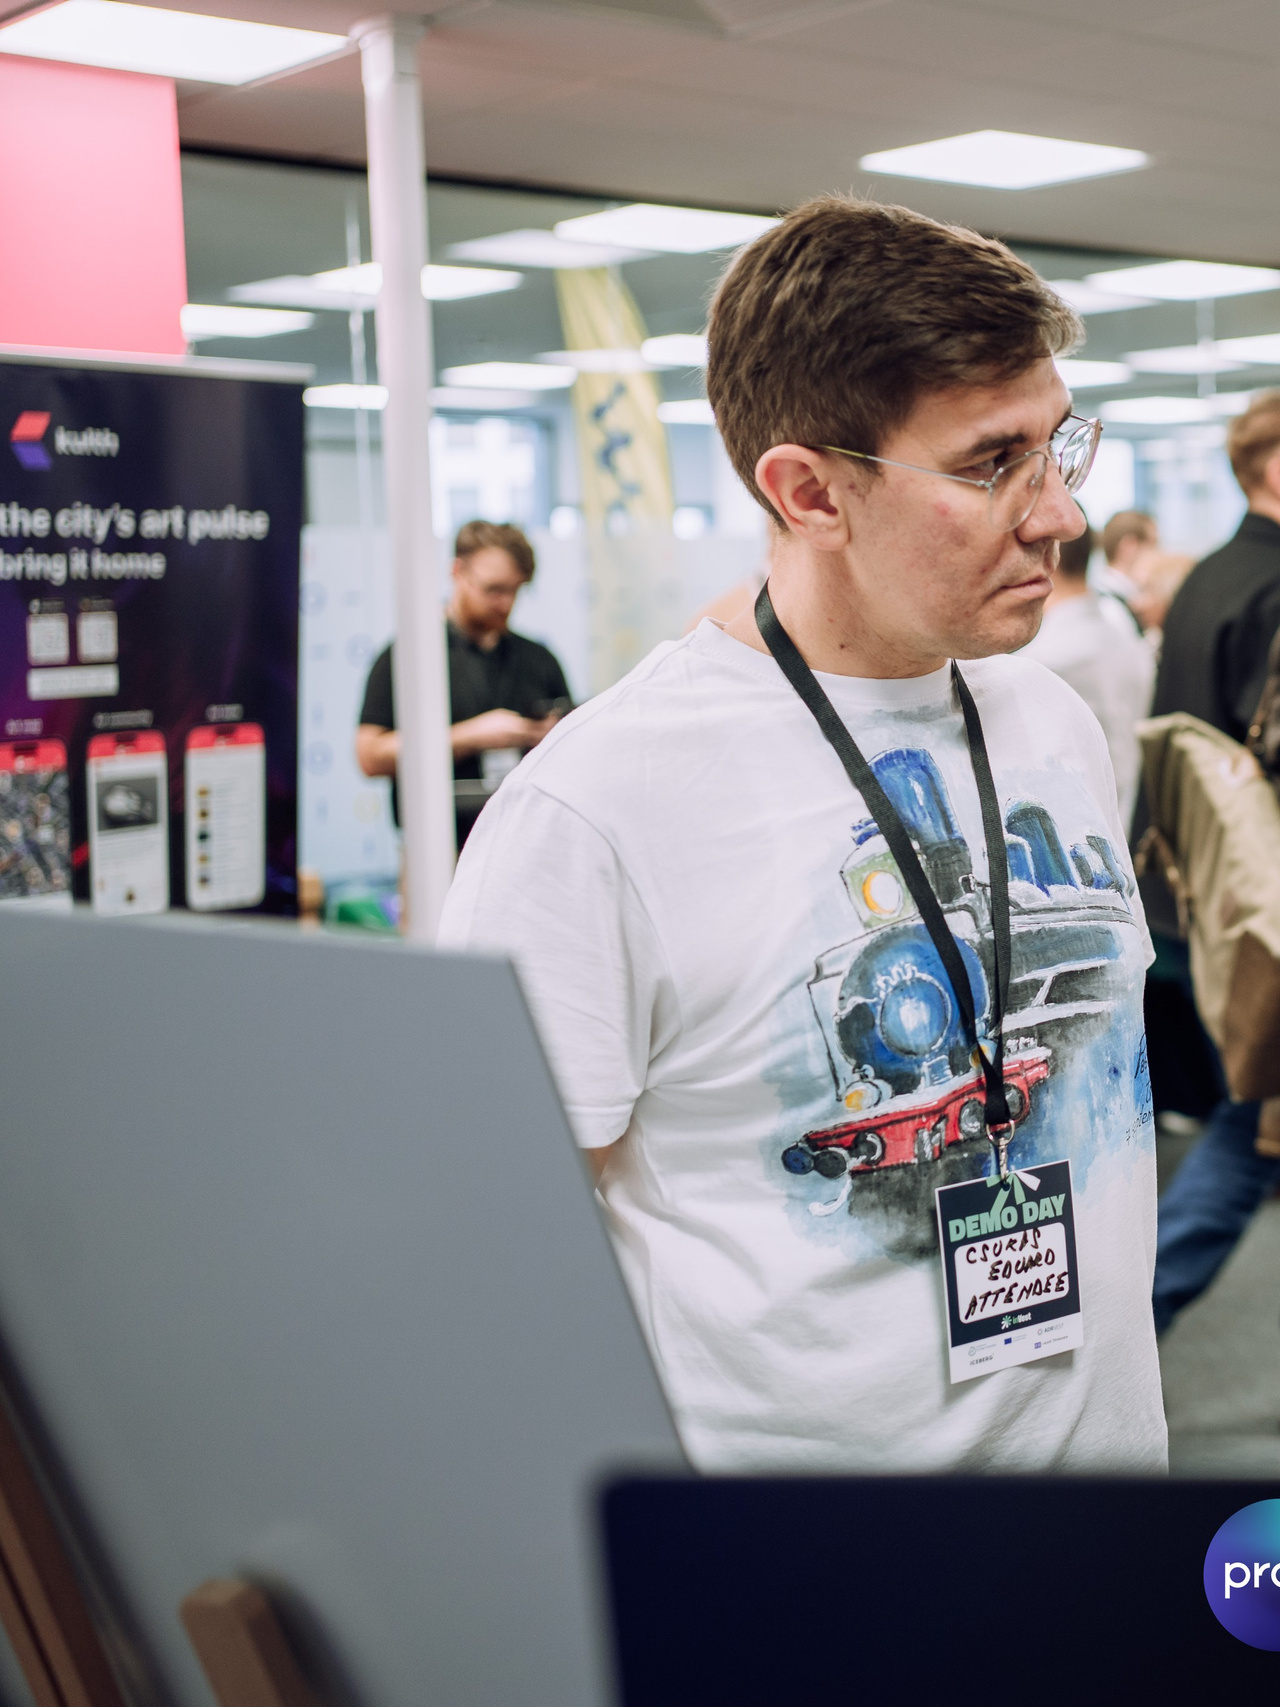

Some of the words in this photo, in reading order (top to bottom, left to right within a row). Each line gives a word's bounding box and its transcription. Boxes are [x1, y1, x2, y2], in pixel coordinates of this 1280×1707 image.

[55, 425, 120, 457] kulth
[0, 501, 51, 538] the
[54, 501, 137, 545] city's
[139, 505, 186, 539] art
[187, 504, 270, 546] pulse
[69, 546, 89, 580] it
[90, 547, 167, 580] home
[948, 1205, 1018, 1242] DEMO
[1022, 1193, 1066, 1225] DAY
[964, 1271, 1069, 1320] ATTENDEE
[969, 1354, 994, 1367] ICEBERG
